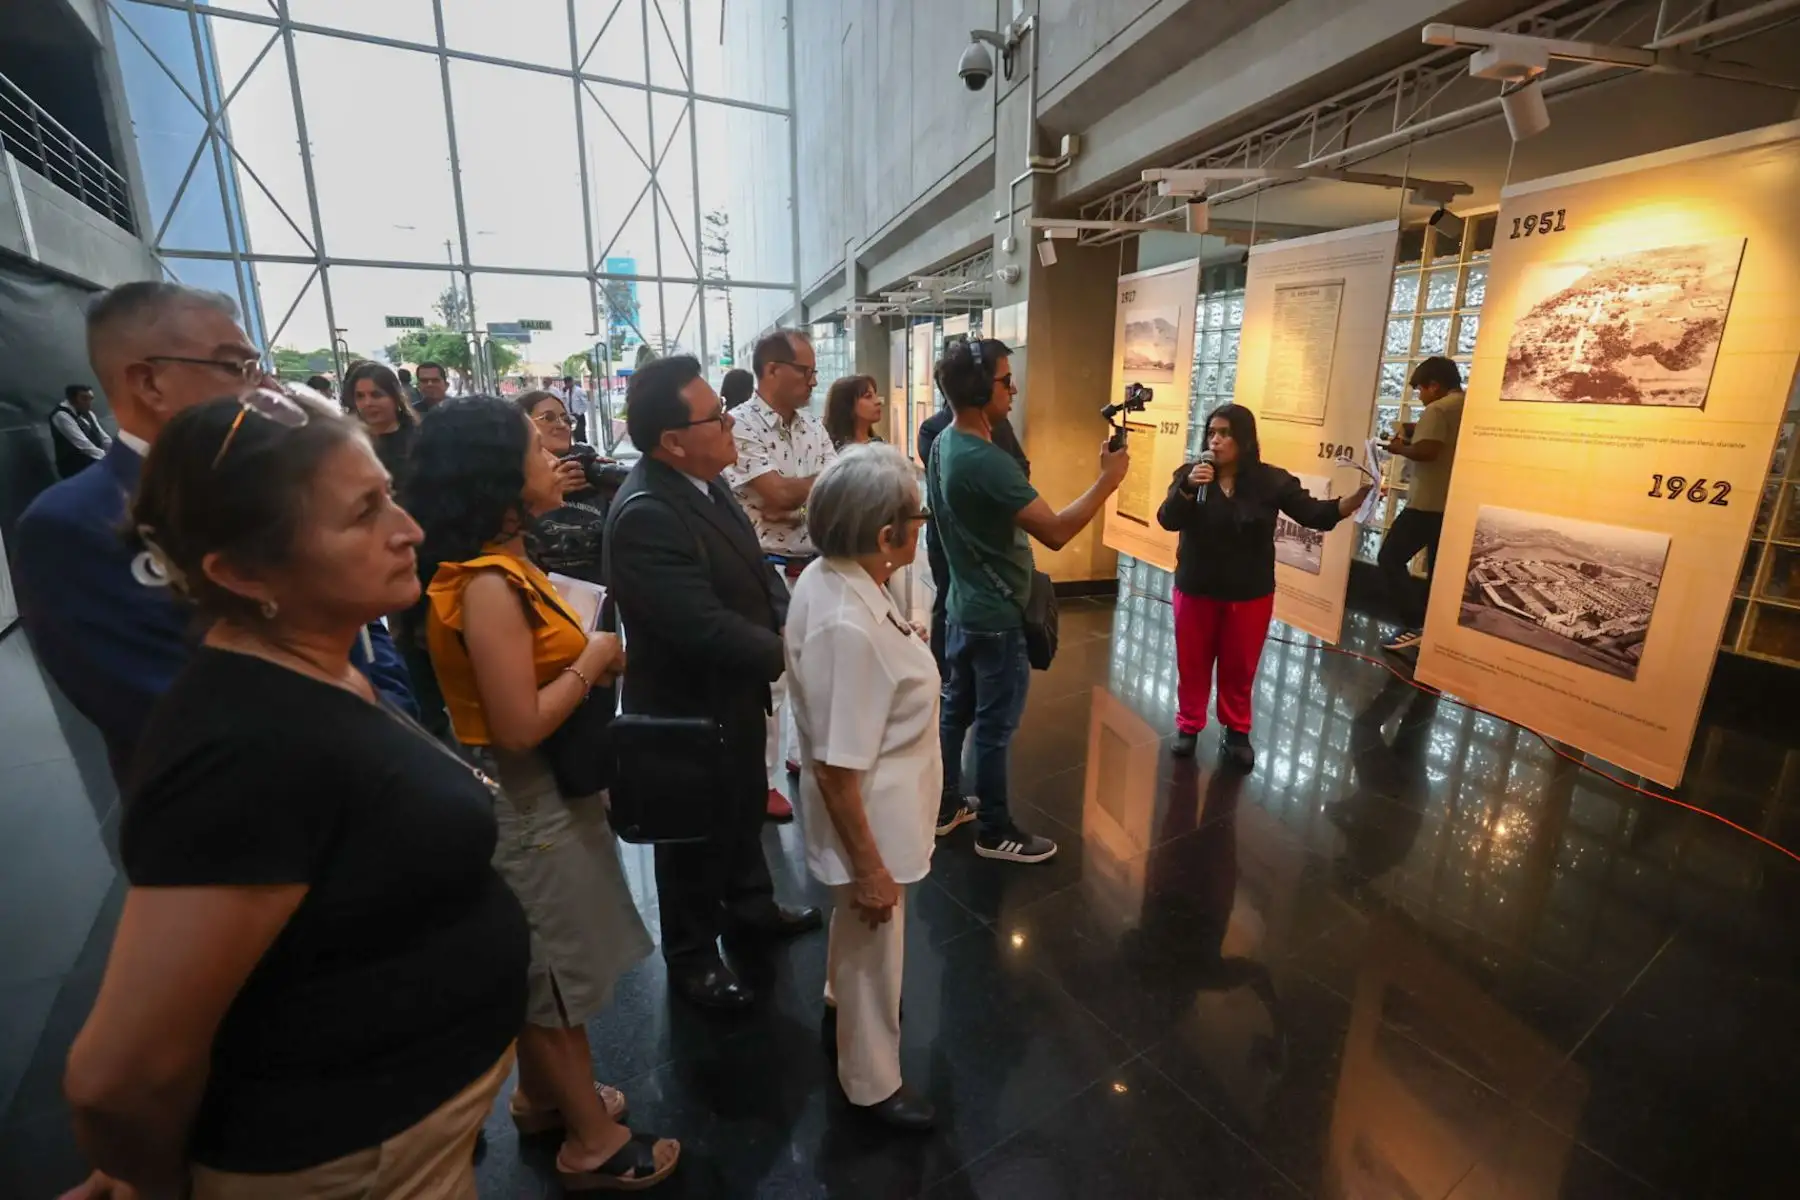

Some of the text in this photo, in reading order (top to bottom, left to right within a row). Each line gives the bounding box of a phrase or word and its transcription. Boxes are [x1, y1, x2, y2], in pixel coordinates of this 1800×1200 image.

[1509, 208, 1566, 239] 1951
[388, 317, 423, 327] SALIDA
[521, 320, 552, 330] SALIDA
[1160, 421, 1180, 435] 1927
[1317, 441, 1354, 460] 1940
[1647, 473, 1732, 506] 1962
